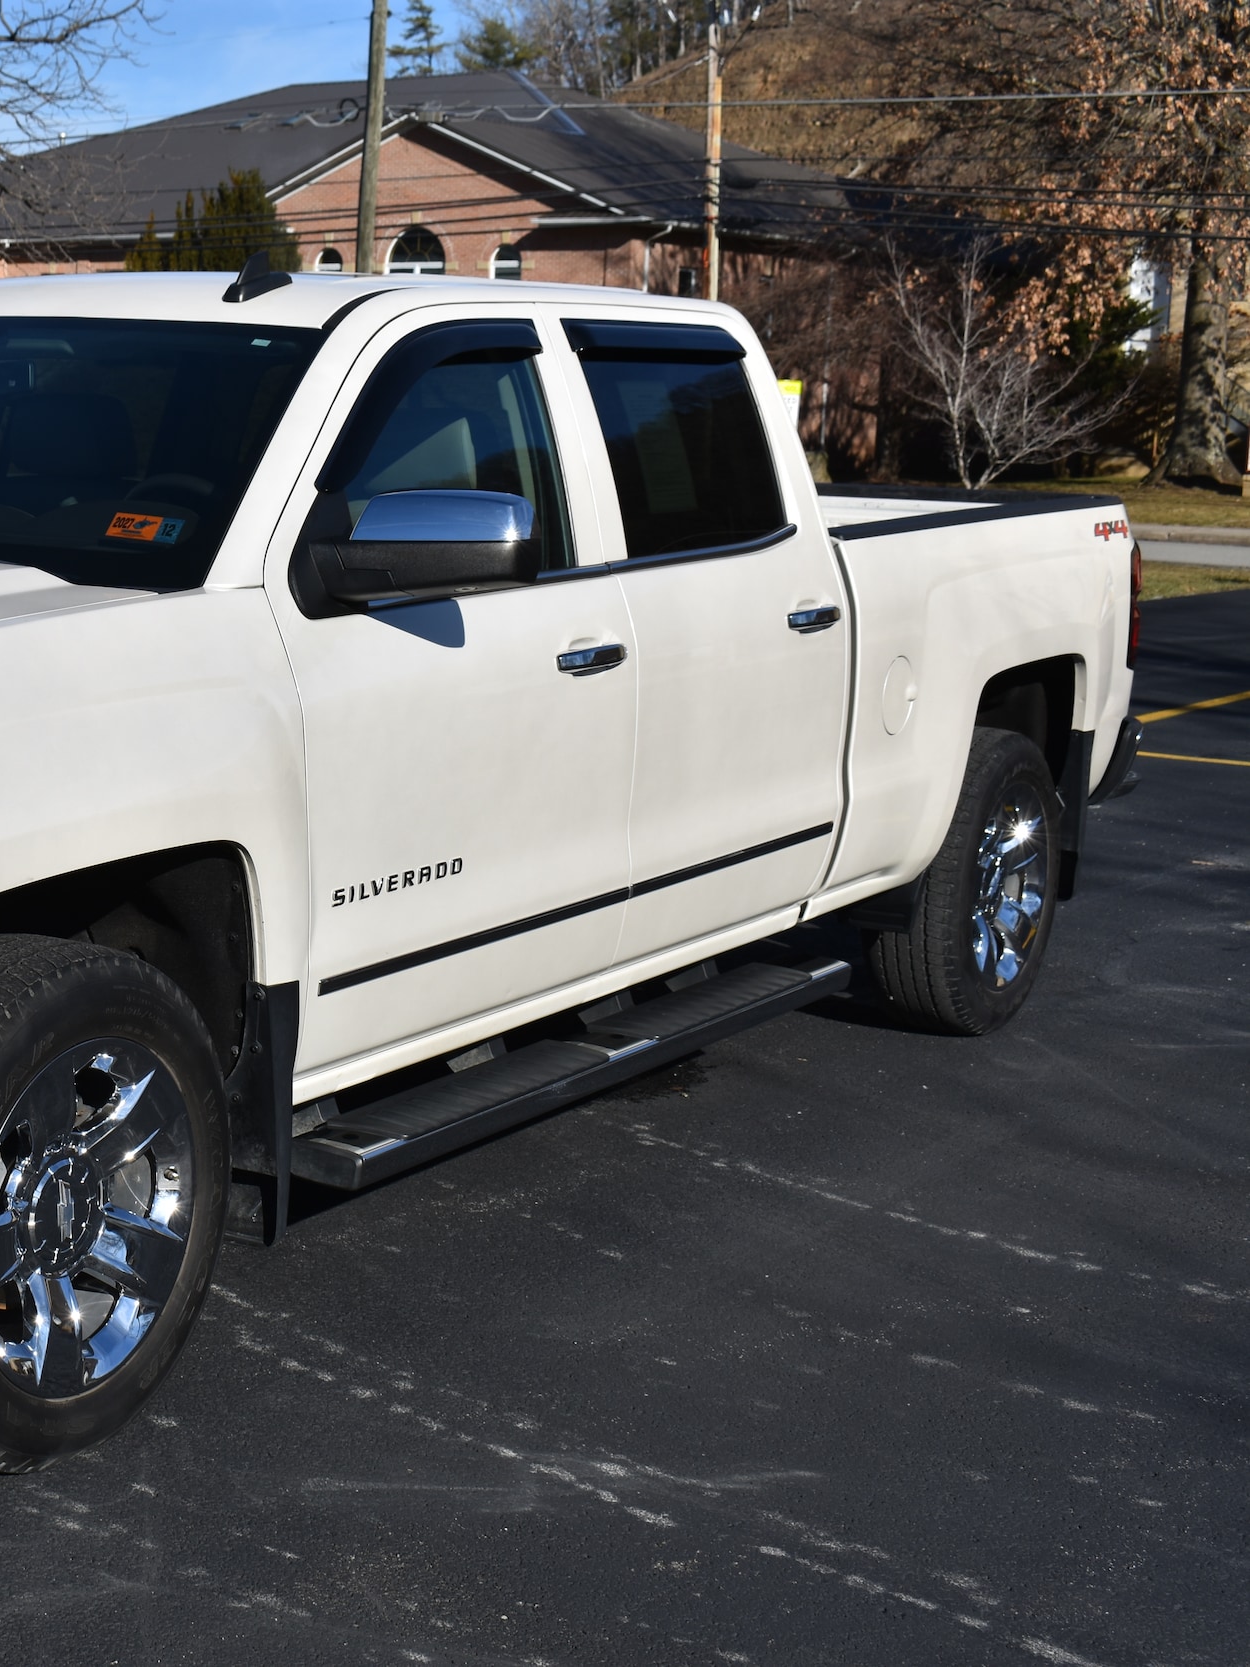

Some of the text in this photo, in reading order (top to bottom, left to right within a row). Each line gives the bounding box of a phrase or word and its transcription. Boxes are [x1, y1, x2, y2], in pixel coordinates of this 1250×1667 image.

[112, 517, 176, 537] 2027 12
[331, 857, 463, 908] SILVERADO
